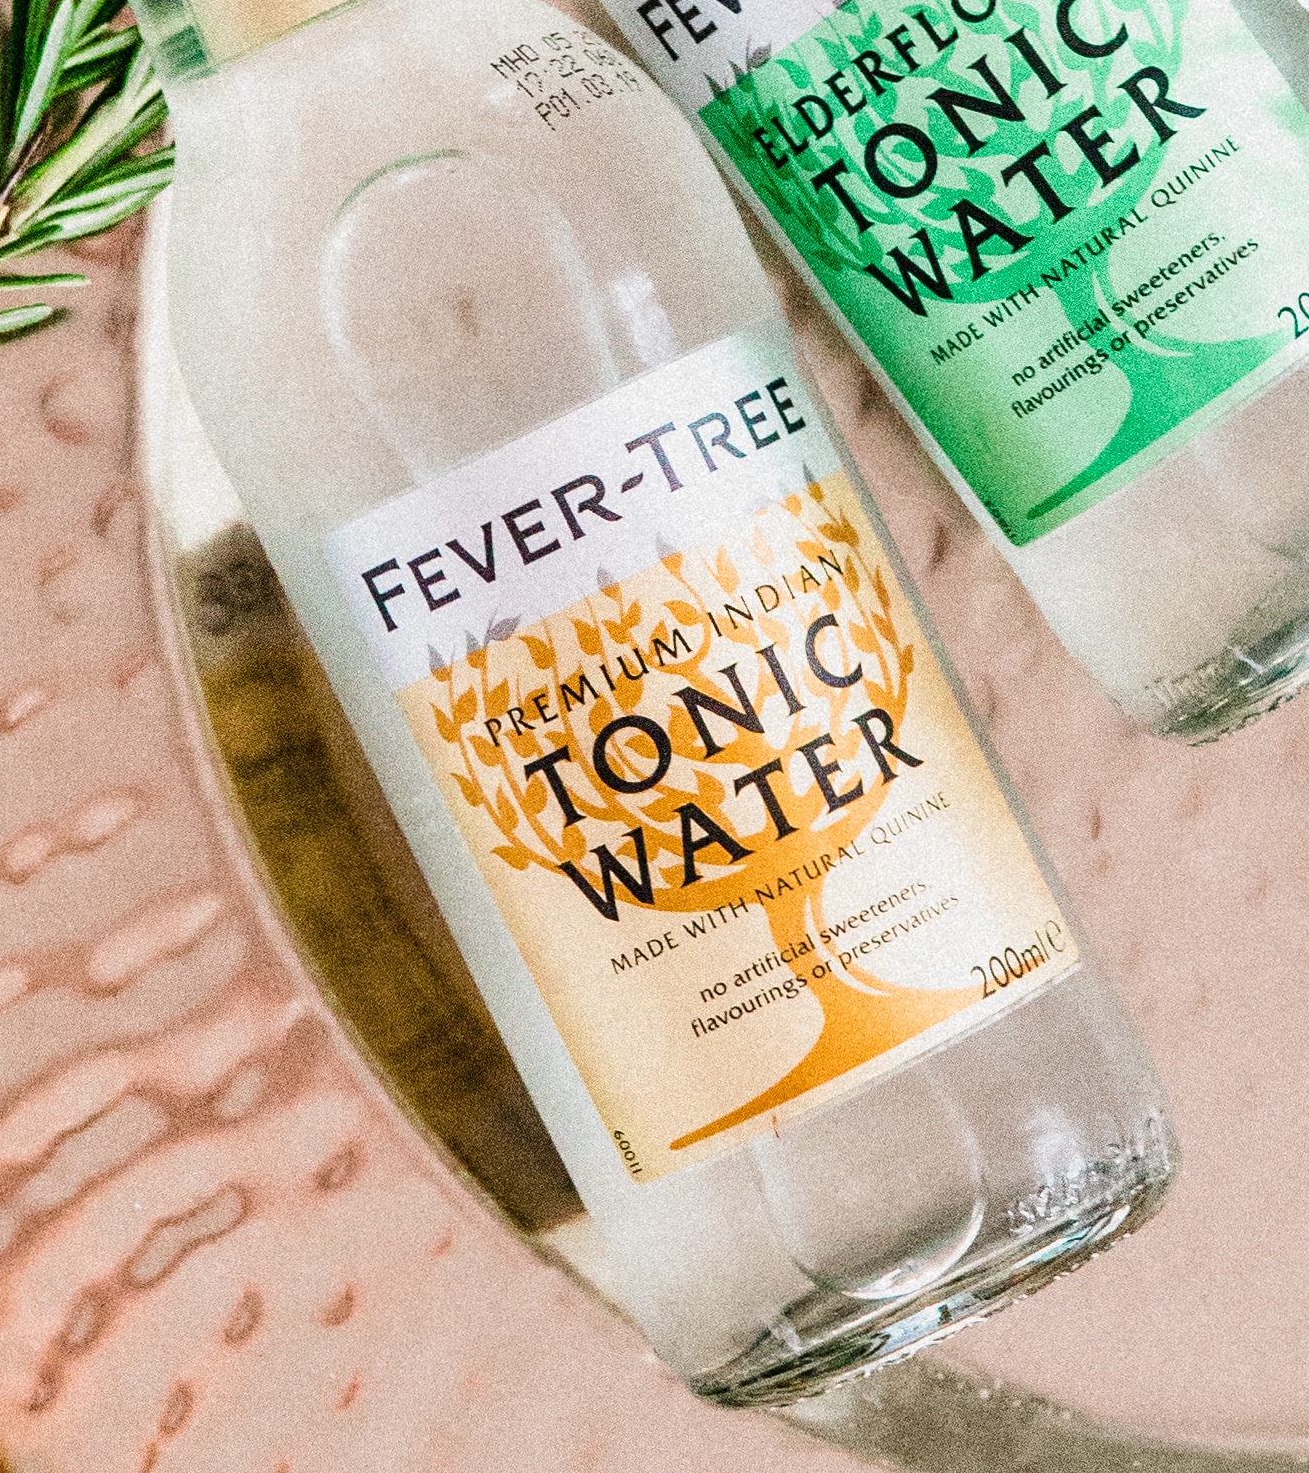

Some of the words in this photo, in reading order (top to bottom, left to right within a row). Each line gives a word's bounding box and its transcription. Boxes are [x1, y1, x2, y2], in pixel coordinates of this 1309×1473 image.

[490, 43, 540, 79] MHD
[862, 63, 1208, 319] WATER
[930, 319, 985, 367] MADE
[981, 280, 1043, 332] WITH
[1039, 208, 1147, 294] NATURAL
[1149, 133, 1243, 211] QUININE
[1011, 343, 1110, 419] flavourings
[1110, 329, 1133, 351] or
[1133, 237, 1260, 340] preservatives
[1011, 362, 1036, 389] no
[1039, 307, 1110, 378] artificial
[359, 373, 807, 632] FEVER-TREE
[484, 628, 692, 749] PREMIUM
[707, 548, 846, 638] INDIAN
[525, 613, 864, 826] TONIC
[558, 710, 926, 923] WATER
[610, 932, 679, 977] MADE
[682, 897, 750, 942] WITH
[754, 841, 867, 910] NATURAL
[870, 791, 952, 848] QUININE
[690, 975, 808, 1039] flavourings
[811, 958, 833, 980] or
[837, 894, 960, 971] preservatives
[699, 980, 728, 1005] no
[732, 935, 816, 989] artificial
